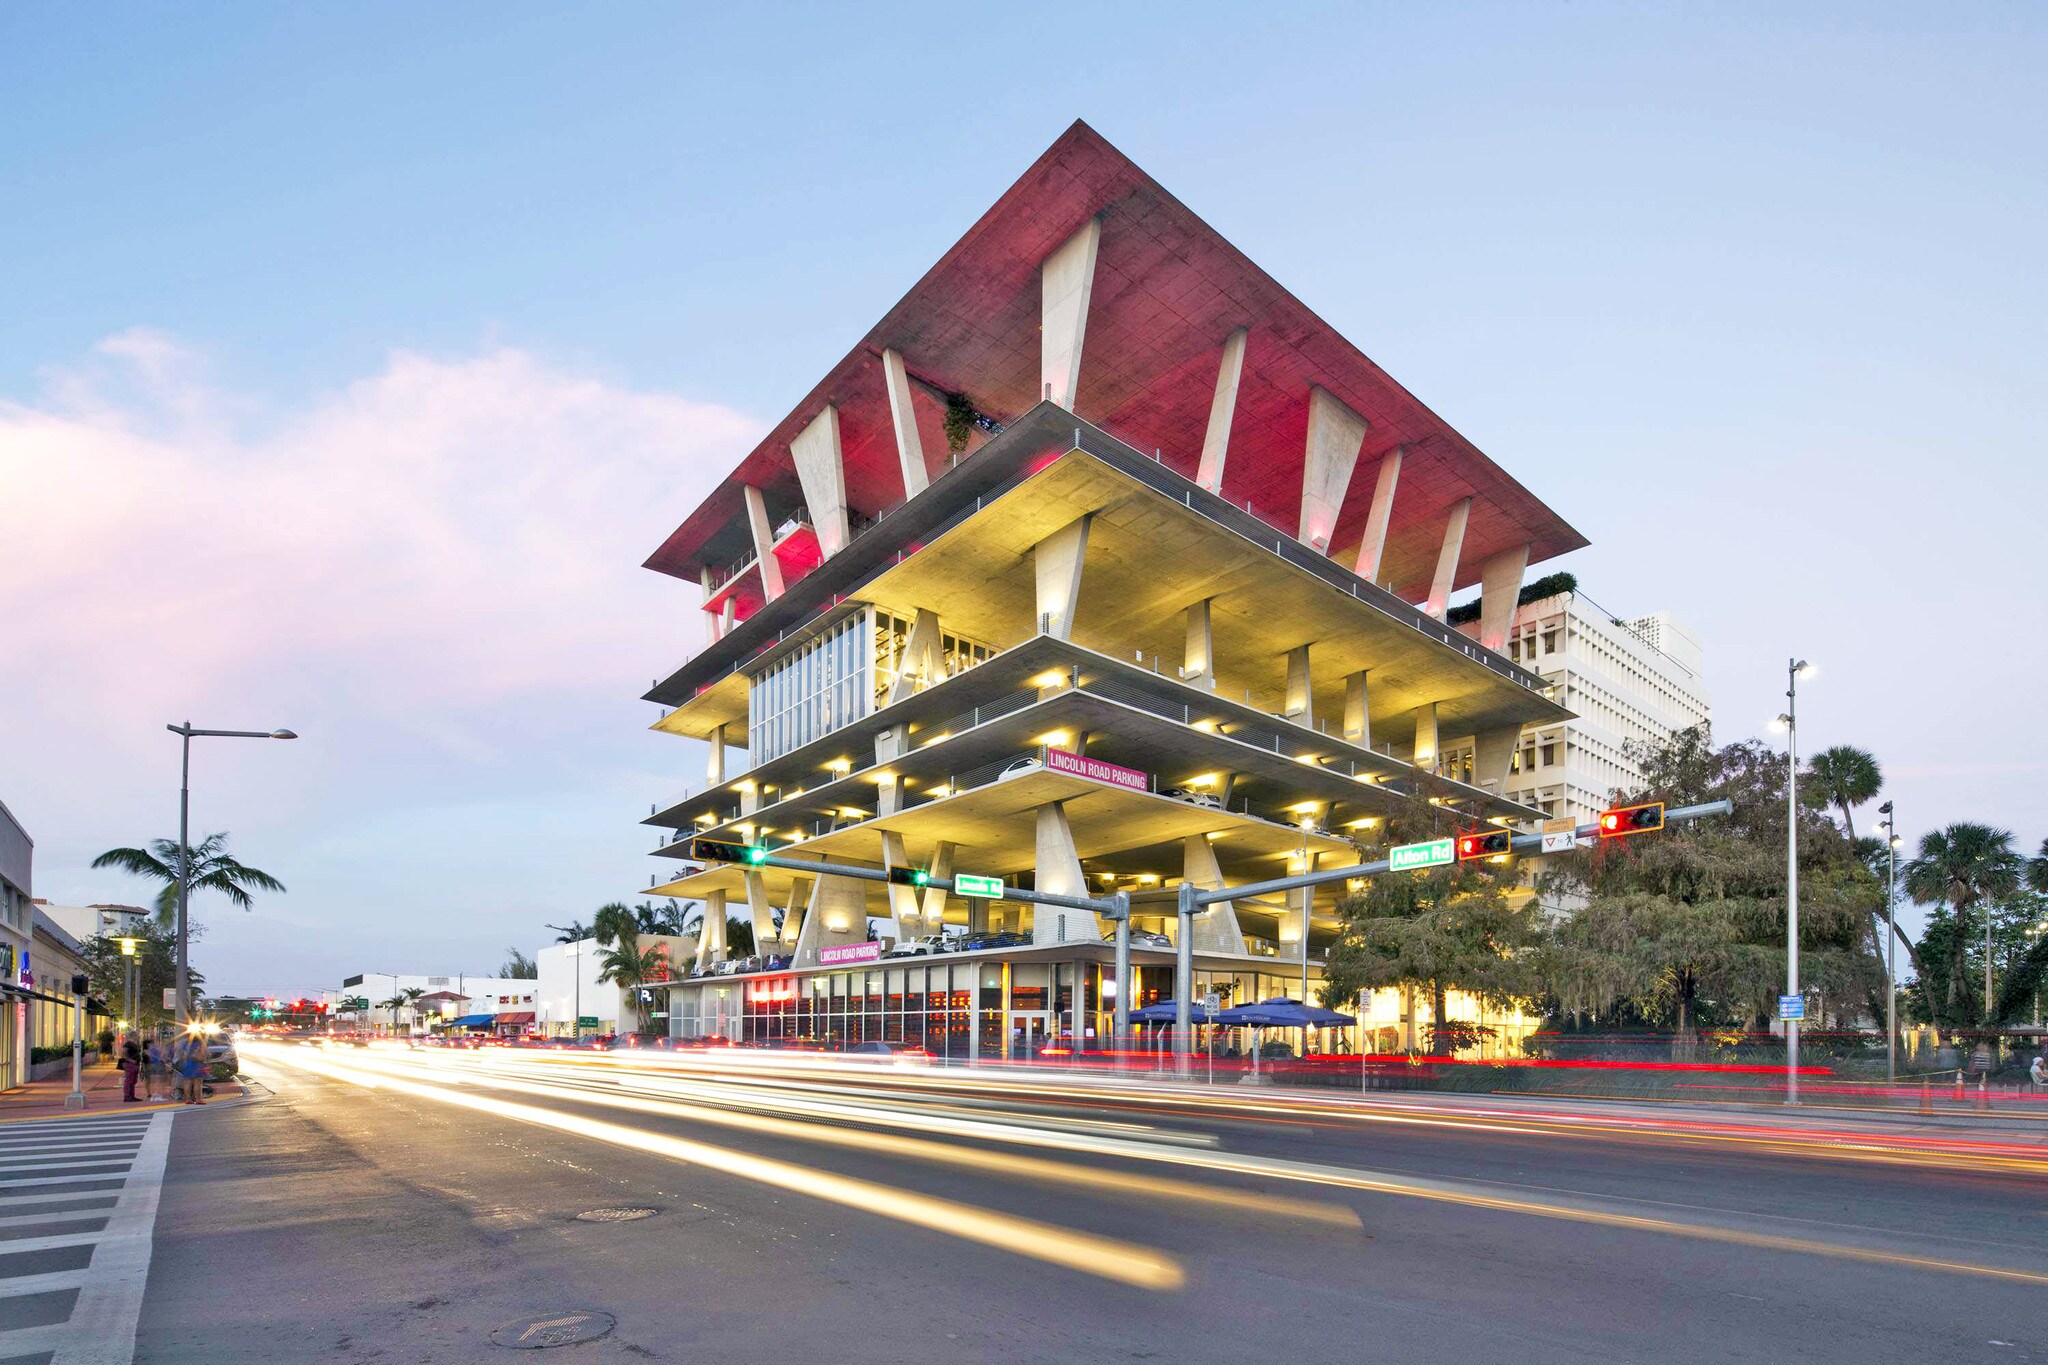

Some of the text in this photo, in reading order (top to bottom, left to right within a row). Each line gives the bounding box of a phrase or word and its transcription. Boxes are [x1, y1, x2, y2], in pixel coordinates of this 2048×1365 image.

[1050, 753, 1145, 789] LINCOLN ROAD PARKING
[1395, 844, 1450, 865] Alton Rd
[821, 945, 878, 962] LINCOLN ROAD PARKING
